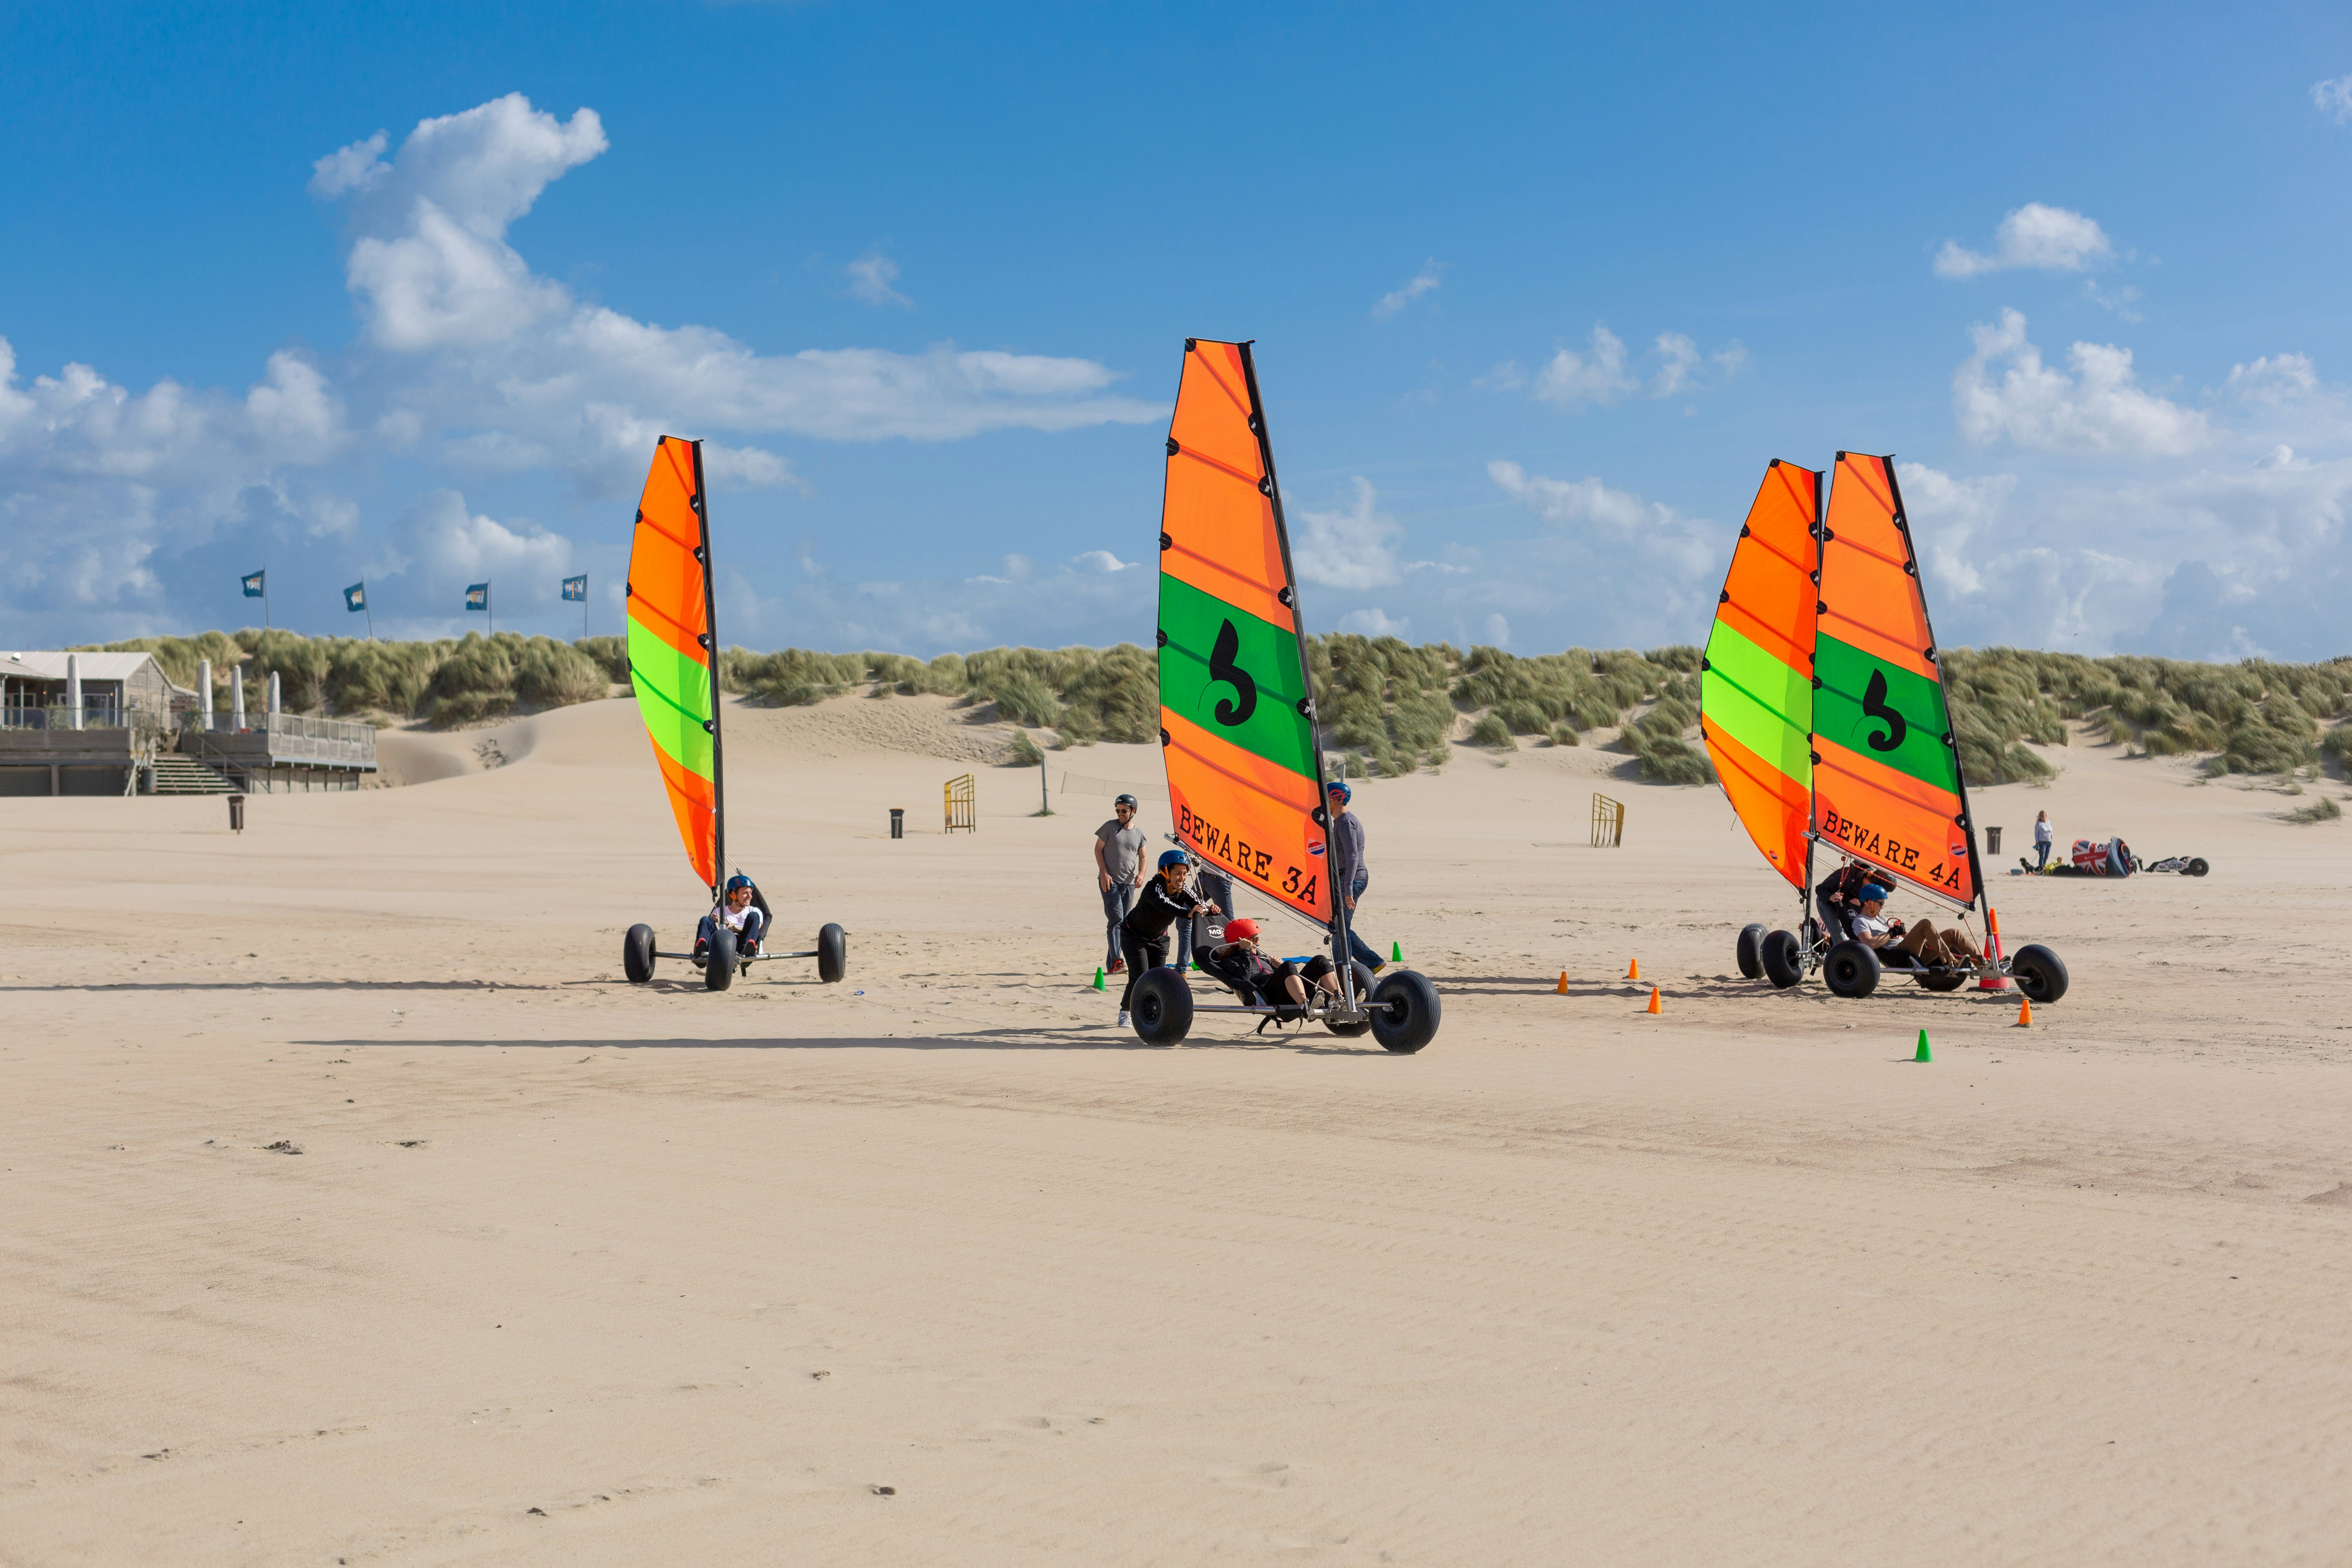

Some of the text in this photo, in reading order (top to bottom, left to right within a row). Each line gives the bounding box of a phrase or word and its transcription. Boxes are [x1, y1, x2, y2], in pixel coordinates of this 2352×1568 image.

[1180, 804, 1316, 905] BEWARE 3A
[1823, 810, 1960, 890] BEWARE 4A
[1348, 969, 1352, 982] 6
